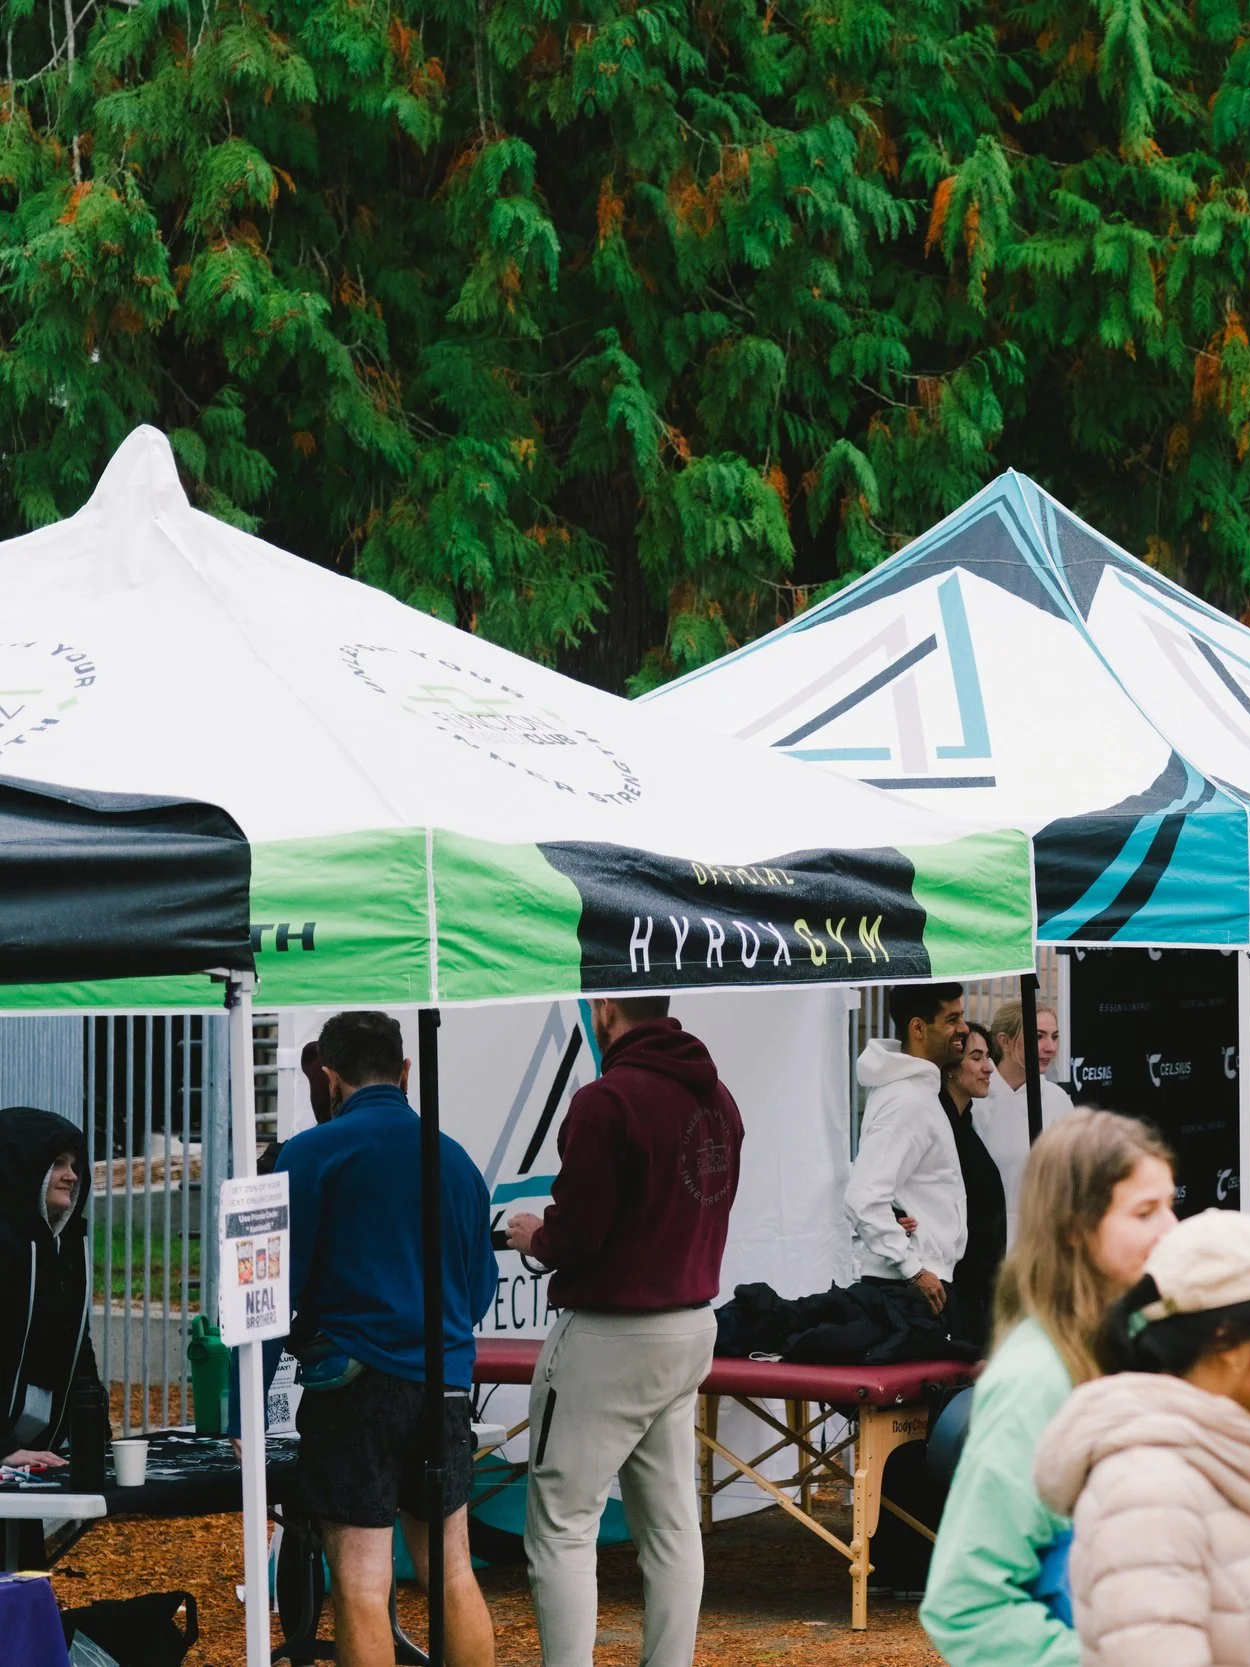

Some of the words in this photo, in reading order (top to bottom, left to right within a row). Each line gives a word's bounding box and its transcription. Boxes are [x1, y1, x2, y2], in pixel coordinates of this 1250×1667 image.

[691, 861, 794, 886] OFFICIAL
[1082, 1065, 1113, 1081] CELSIUS
[1160, 1061, 1192, 1076] CELSIUS
[246, 1286, 276, 1316] NEAL
[246, 1311, 277, 1330] BROTHERS
